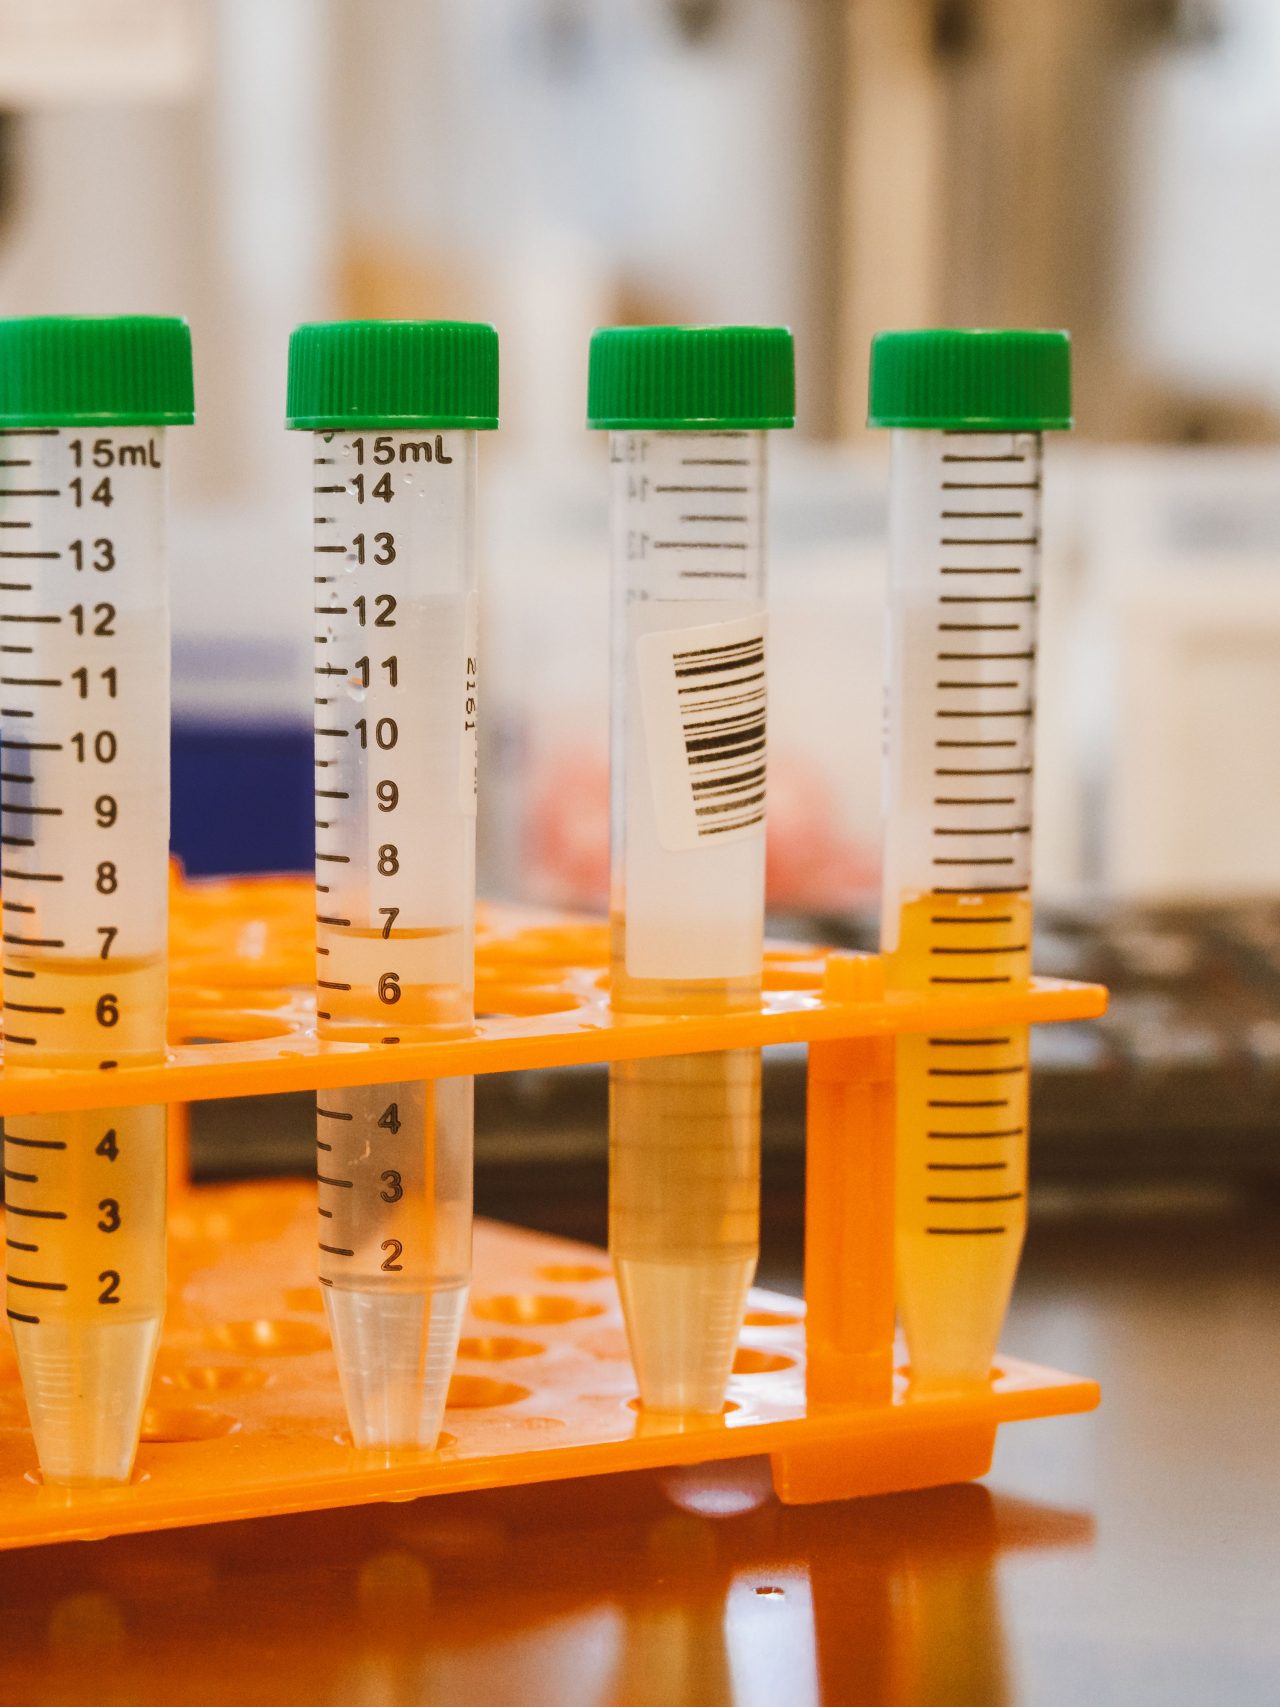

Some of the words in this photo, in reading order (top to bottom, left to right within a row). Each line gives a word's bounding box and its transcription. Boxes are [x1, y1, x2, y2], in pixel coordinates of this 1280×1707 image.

[68, 439, 161, 469] 15mL
[351, 434, 453, 466] 15mL
[68, 476, 114, 508] 14
[351, 472, 395, 504] 14
[68, 537, 116, 572] 13
[352, 531, 397, 565] 13
[69, 602, 117, 638] 12
[352, 594, 398, 627] 12
[71, 666, 118, 699] 11
[354, 655, 399, 688] 11
[464, 657, 477, 732] 2161
[70, 730, 118, 763] 10
[354, 717, 399, 750] 10
[94, 795, 118, 829] 9
[376, 779, 400, 813] 9
[376, 842, 400, 876] 8
[96, 861, 118, 895] 8
[378, 907, 400, 940] 7
[96, 927, 118, 959] 7
[377, 971, 402, 1005] 6
[95, 993, 119, 1027] 6
[377, 1103, 401, 1135] 4
[95, 1129, 119, 1161] 4
[380, 1169, 404, 1203] 3
[97, 1198, 121, 1233] 3
[380, 1239, 403, 1271] 2
[98, 1270, 121, 1304] 2
